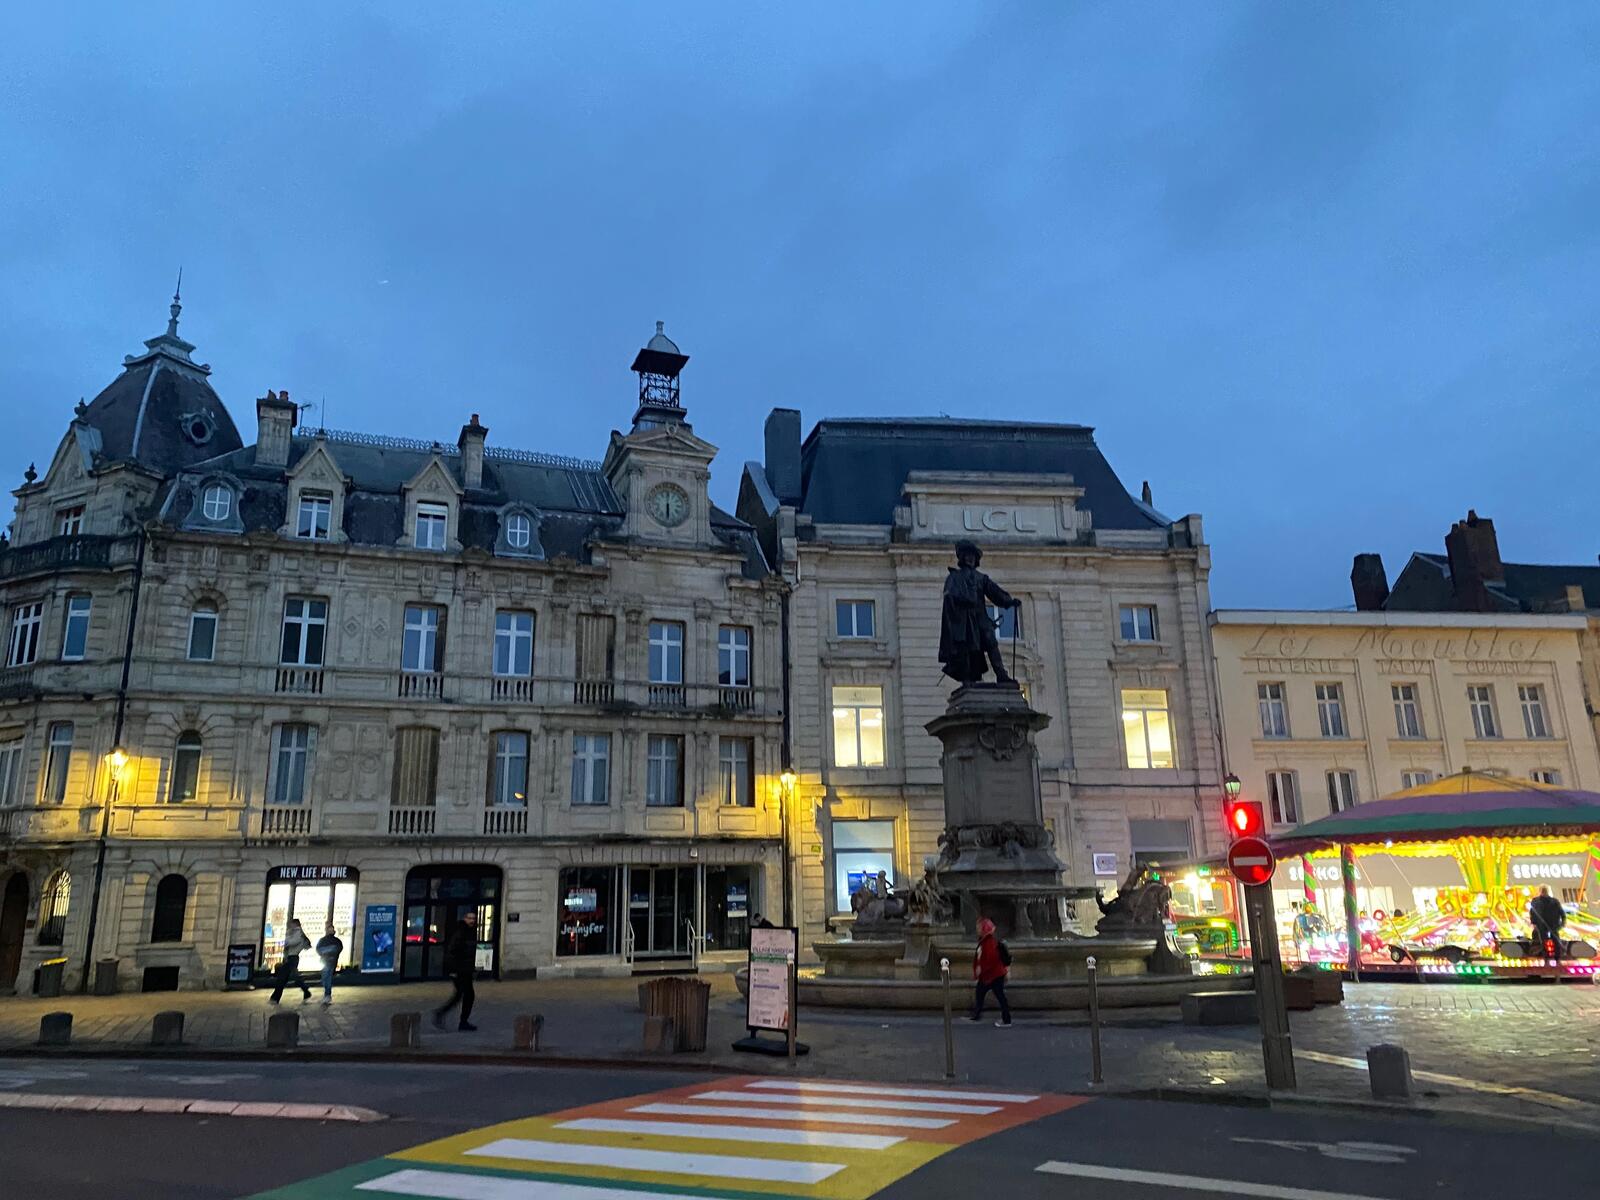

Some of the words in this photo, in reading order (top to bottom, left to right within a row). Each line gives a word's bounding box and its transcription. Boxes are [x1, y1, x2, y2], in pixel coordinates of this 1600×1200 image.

[962, 508, 1037, 532] LCL
[280, 866, 298, 878] NEW
[301, 866, 318, 878] LIFE
[1512, 863, 1583, 879] SEPHORA
[560, 923, 604, 937] Jennyfer
